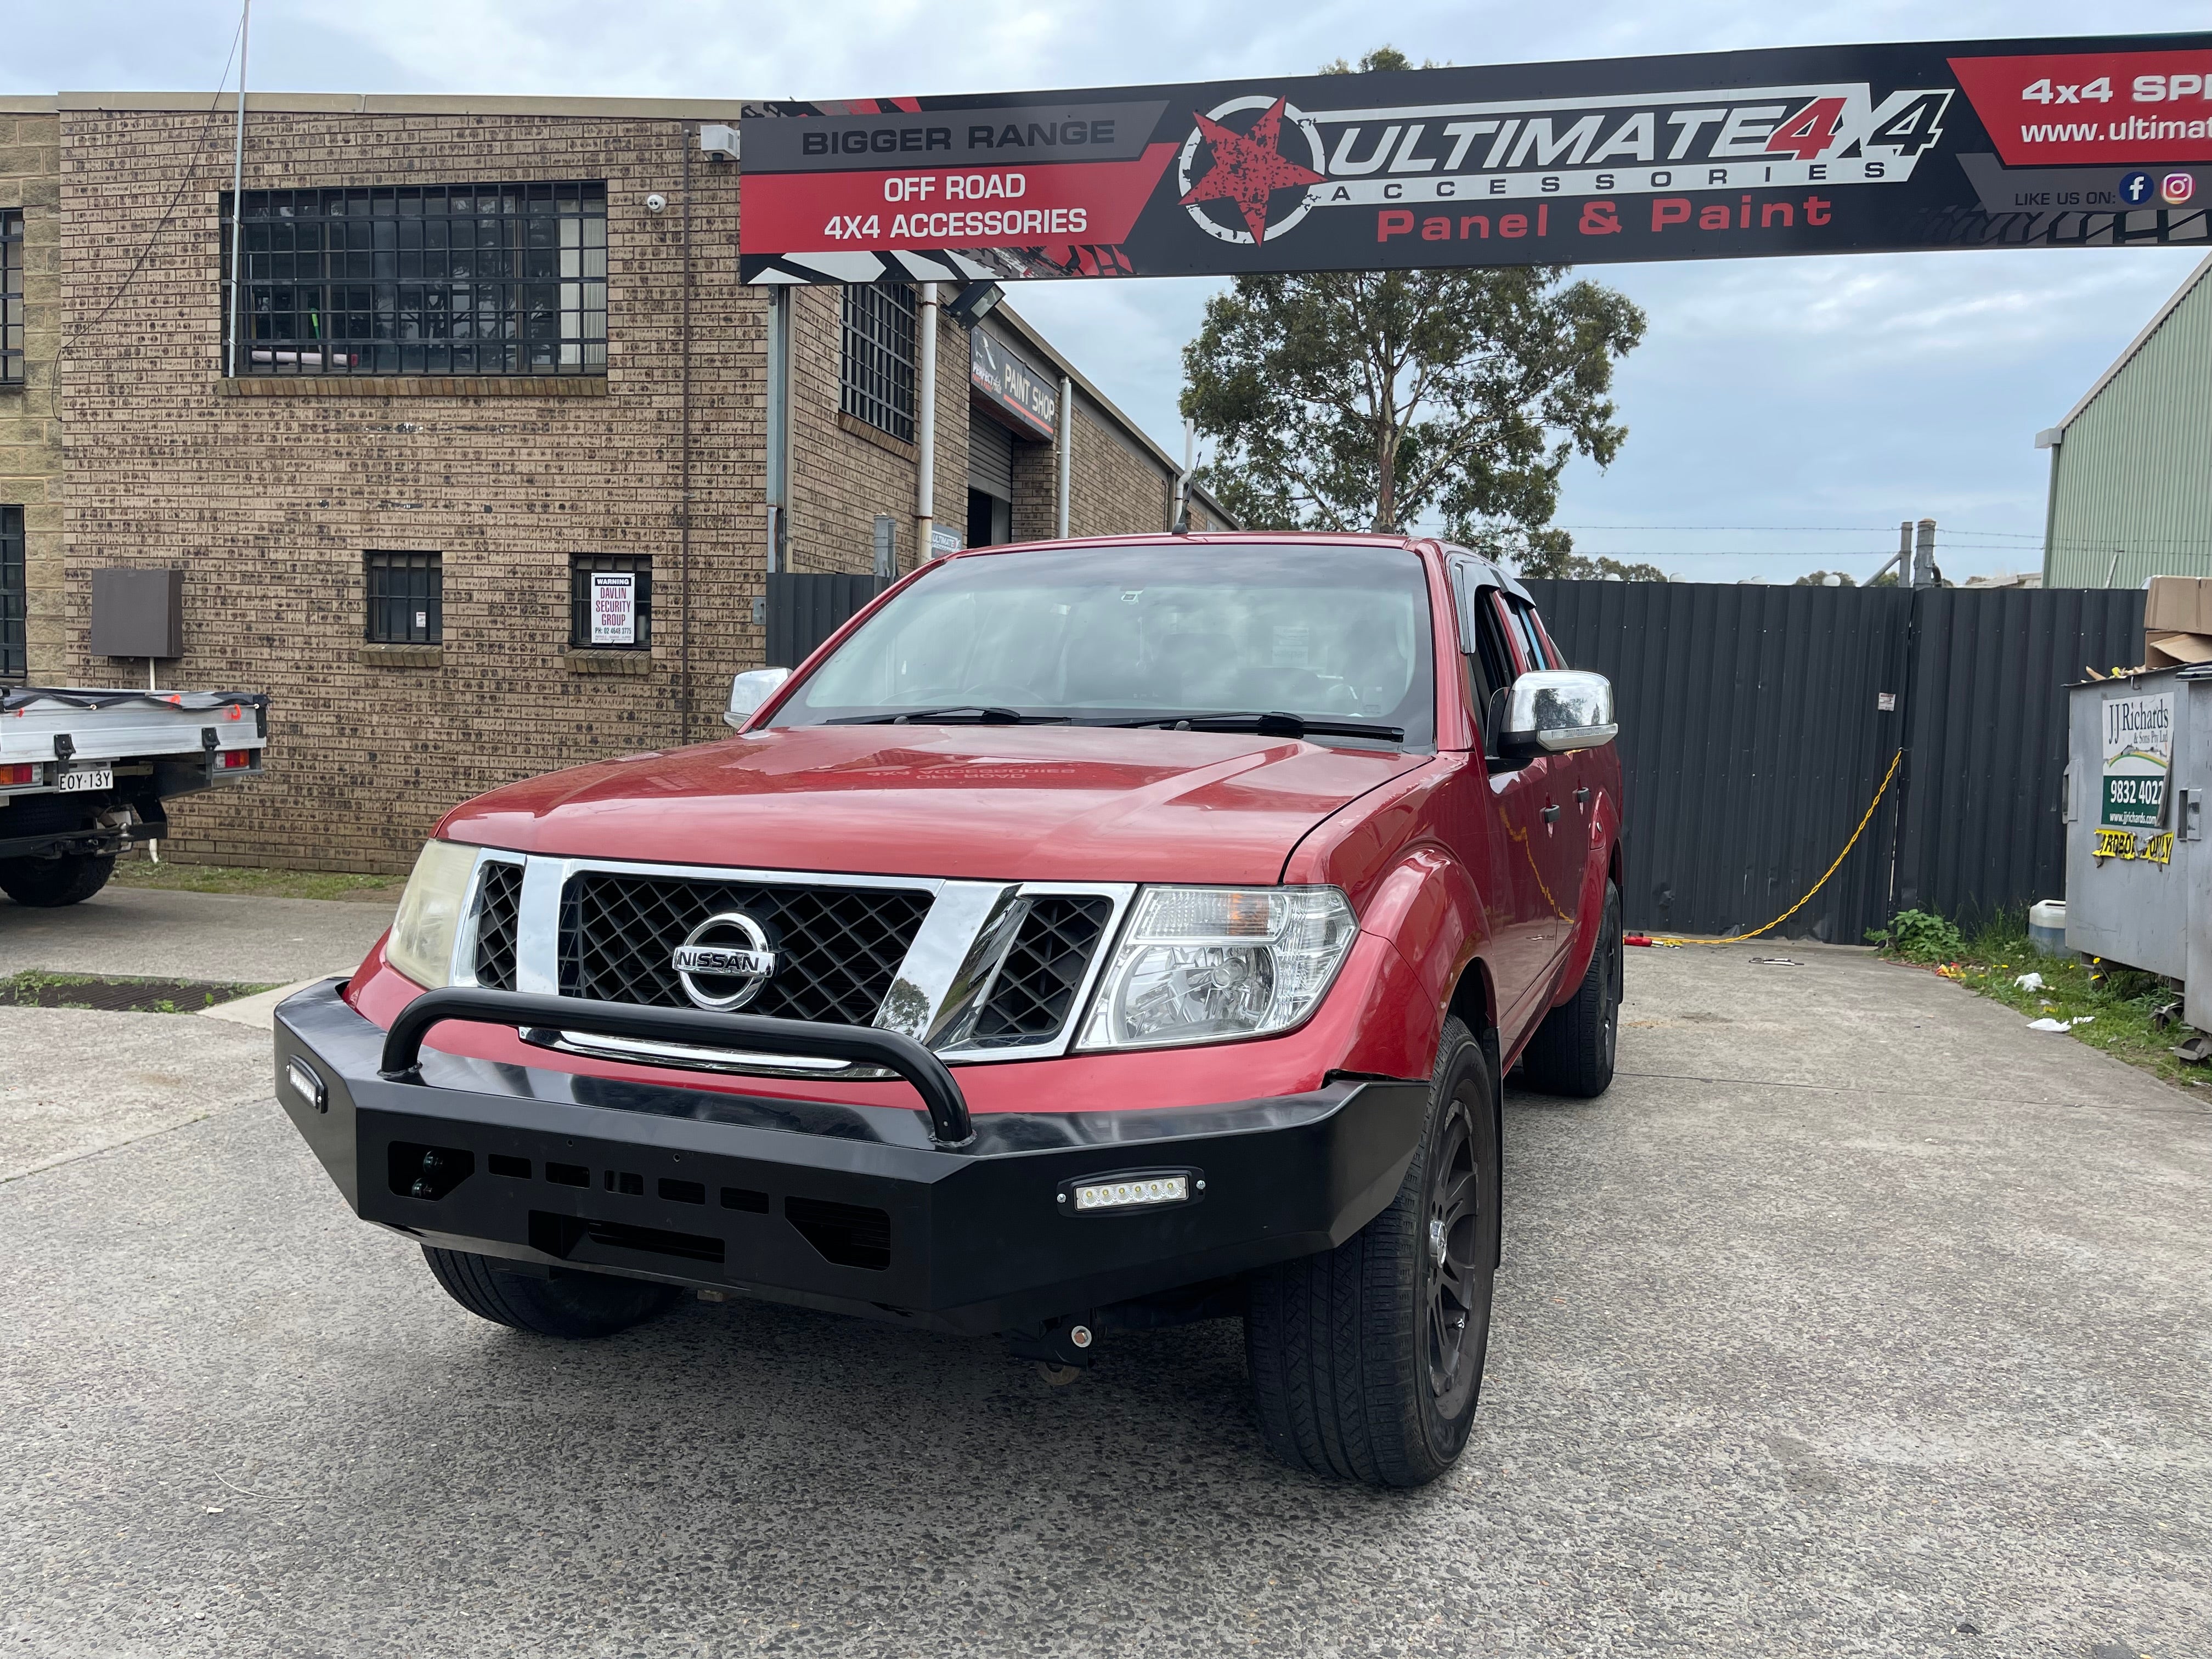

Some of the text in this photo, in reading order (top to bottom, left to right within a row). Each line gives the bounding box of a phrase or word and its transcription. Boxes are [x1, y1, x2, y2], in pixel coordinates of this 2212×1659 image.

[2022, 77, 2113, 104] 4x4
[803, 120, 1115, 156] BIGGER RANGE
[884, 173, 1025, 202] OFF ROAD
[1330, 162, 1885, 201] ACCESSORIES
[2015, 191, 2117, 206] LIKE US ON:
[824, 208, 1087, 240] 4X4 ACCESSORIES
[1377, 195, 1831, 243] Panel & Paint
[1005, 363, 1030, 405] PAINT
[1032, 386, 1055, 422] SHOP
[600, 587, 627, 599] DAVLIN
[596, 600, 631, 612] SECURITY
[602, 614, 625, 625] GROUP
[2140, 731, 2150, 743] Sons
[2111, 780, 2136, 804] 9832
[679, 952, 759, 971] NISSAN
